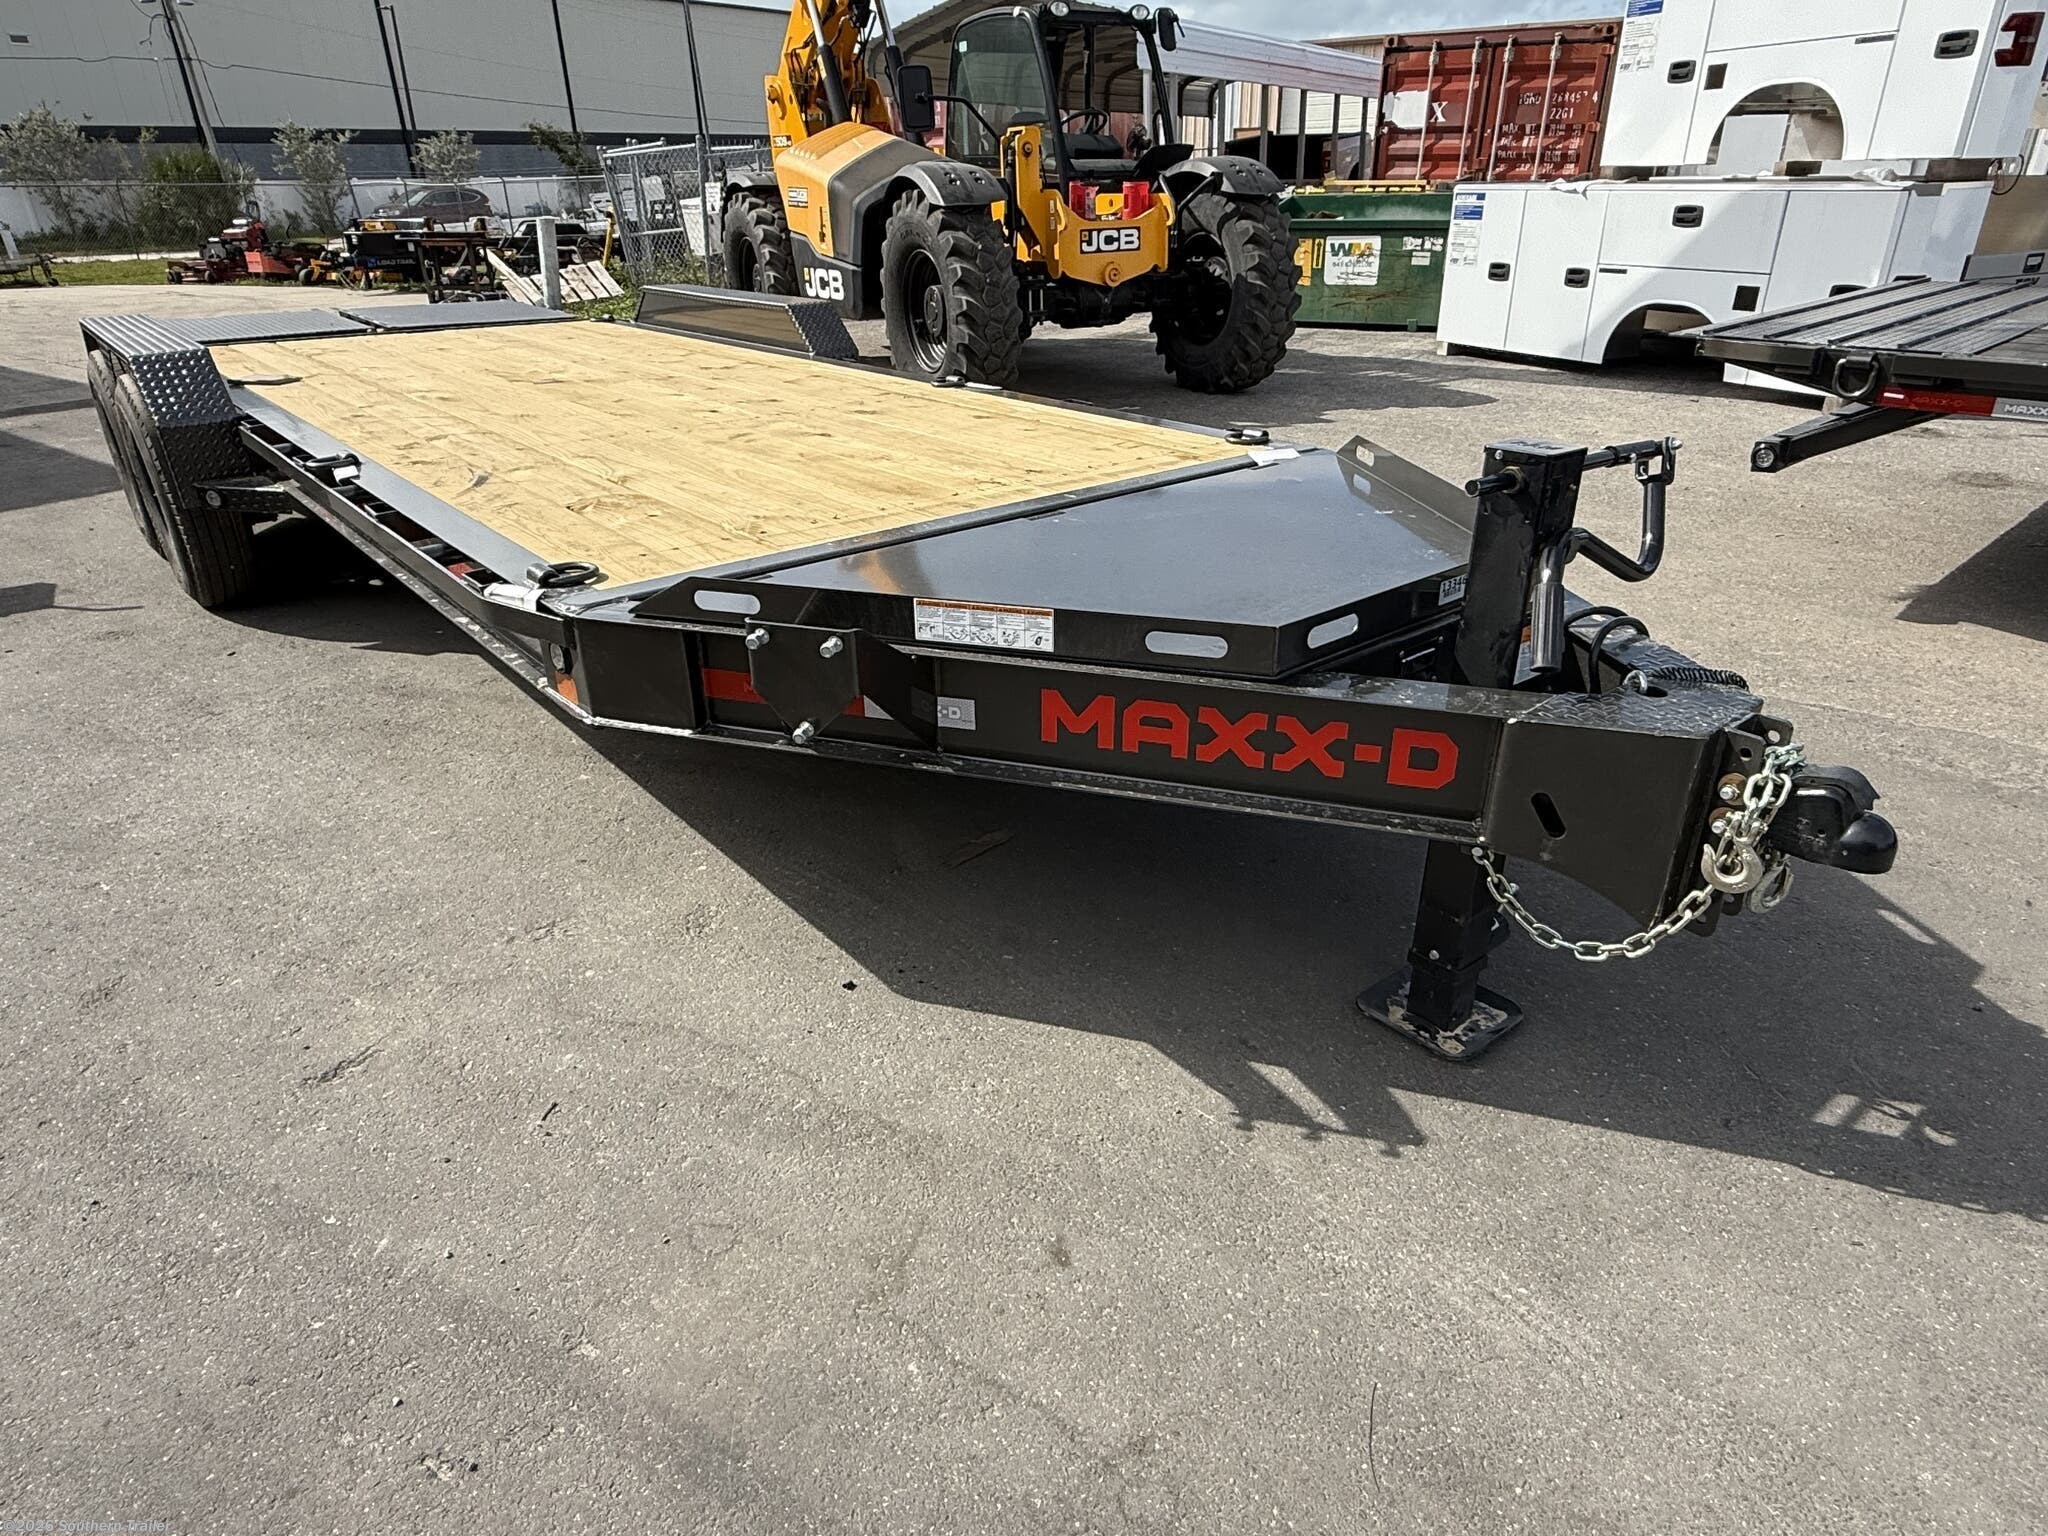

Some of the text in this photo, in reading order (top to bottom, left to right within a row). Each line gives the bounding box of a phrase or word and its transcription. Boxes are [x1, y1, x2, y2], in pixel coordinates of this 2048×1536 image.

[1431, 101, 1449, 123] X
[1081, 228, 1140, 253] JCB
[1329, 242, 1374, 258] WM
[803, 267, 845, 301] JCB
[1041, 688, 1459, 790] MAXX-D
